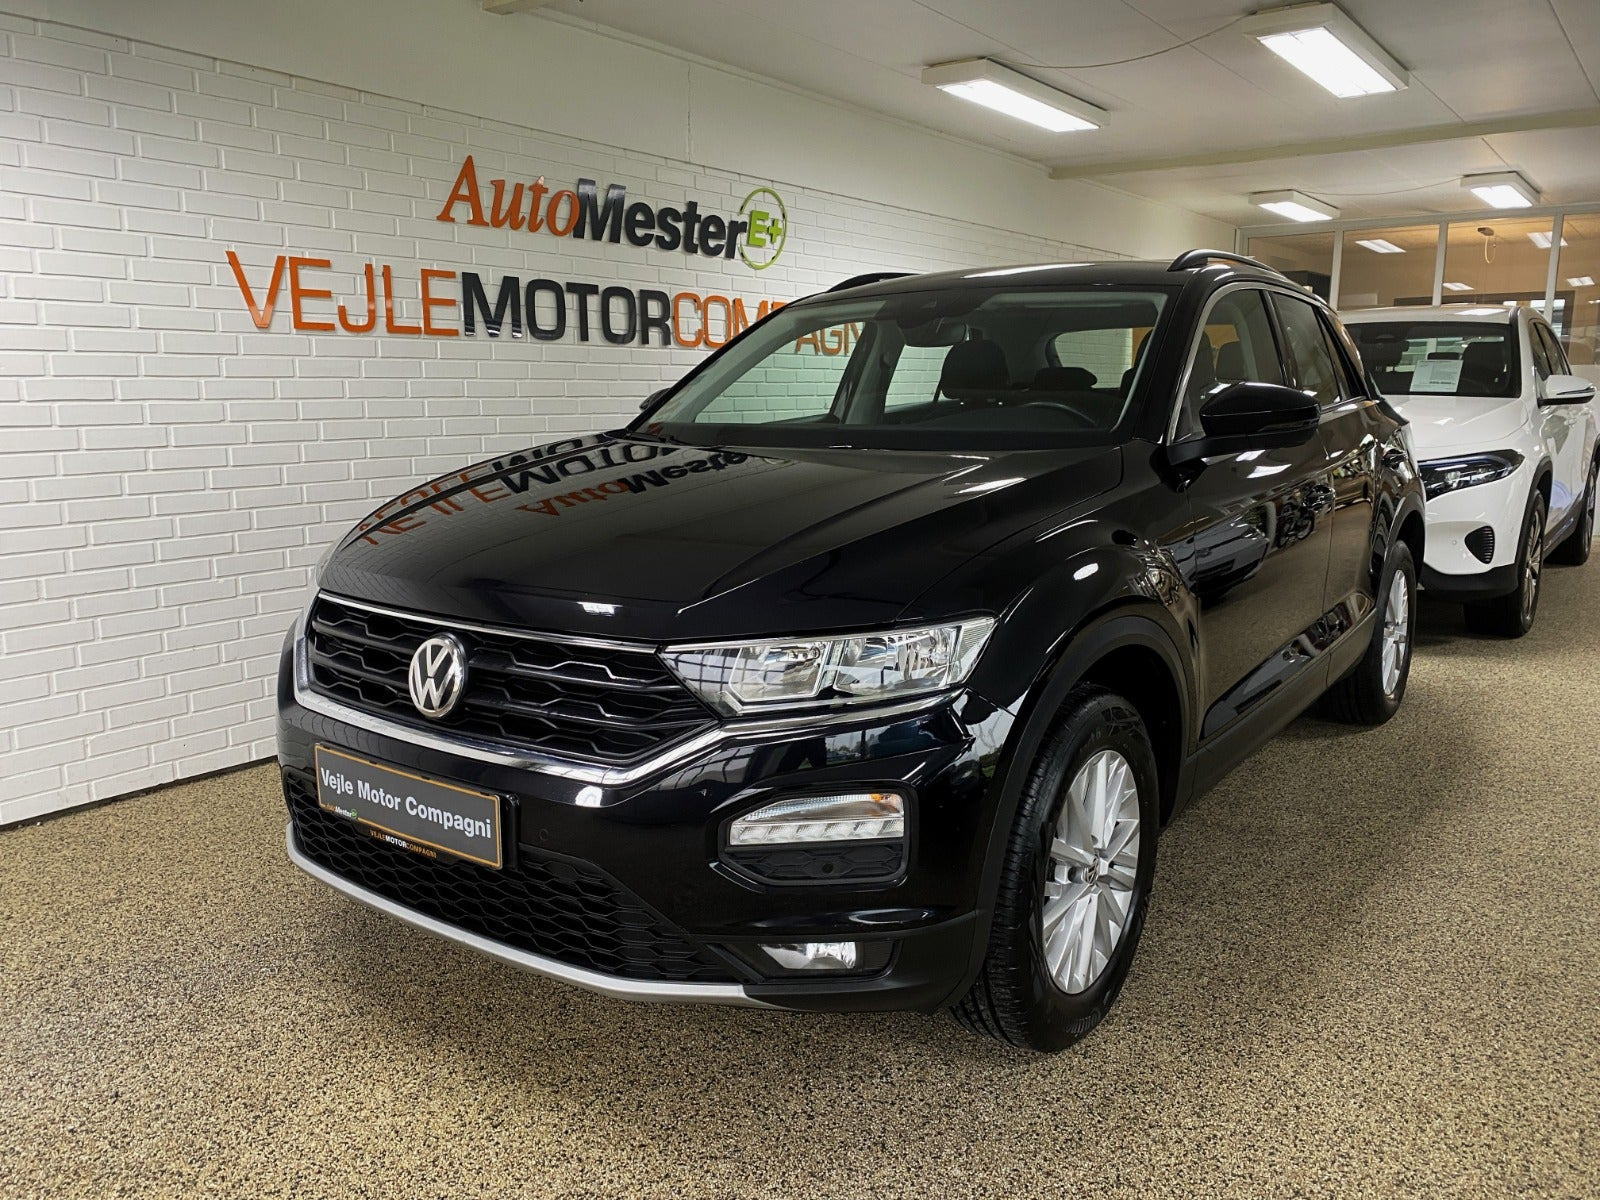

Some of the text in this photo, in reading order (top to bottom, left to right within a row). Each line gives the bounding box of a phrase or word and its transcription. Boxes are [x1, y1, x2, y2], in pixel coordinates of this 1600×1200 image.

[436, 155, 747, 260] AutoMester
[320, 767, 491, 838] Vejle Motor Compagni
